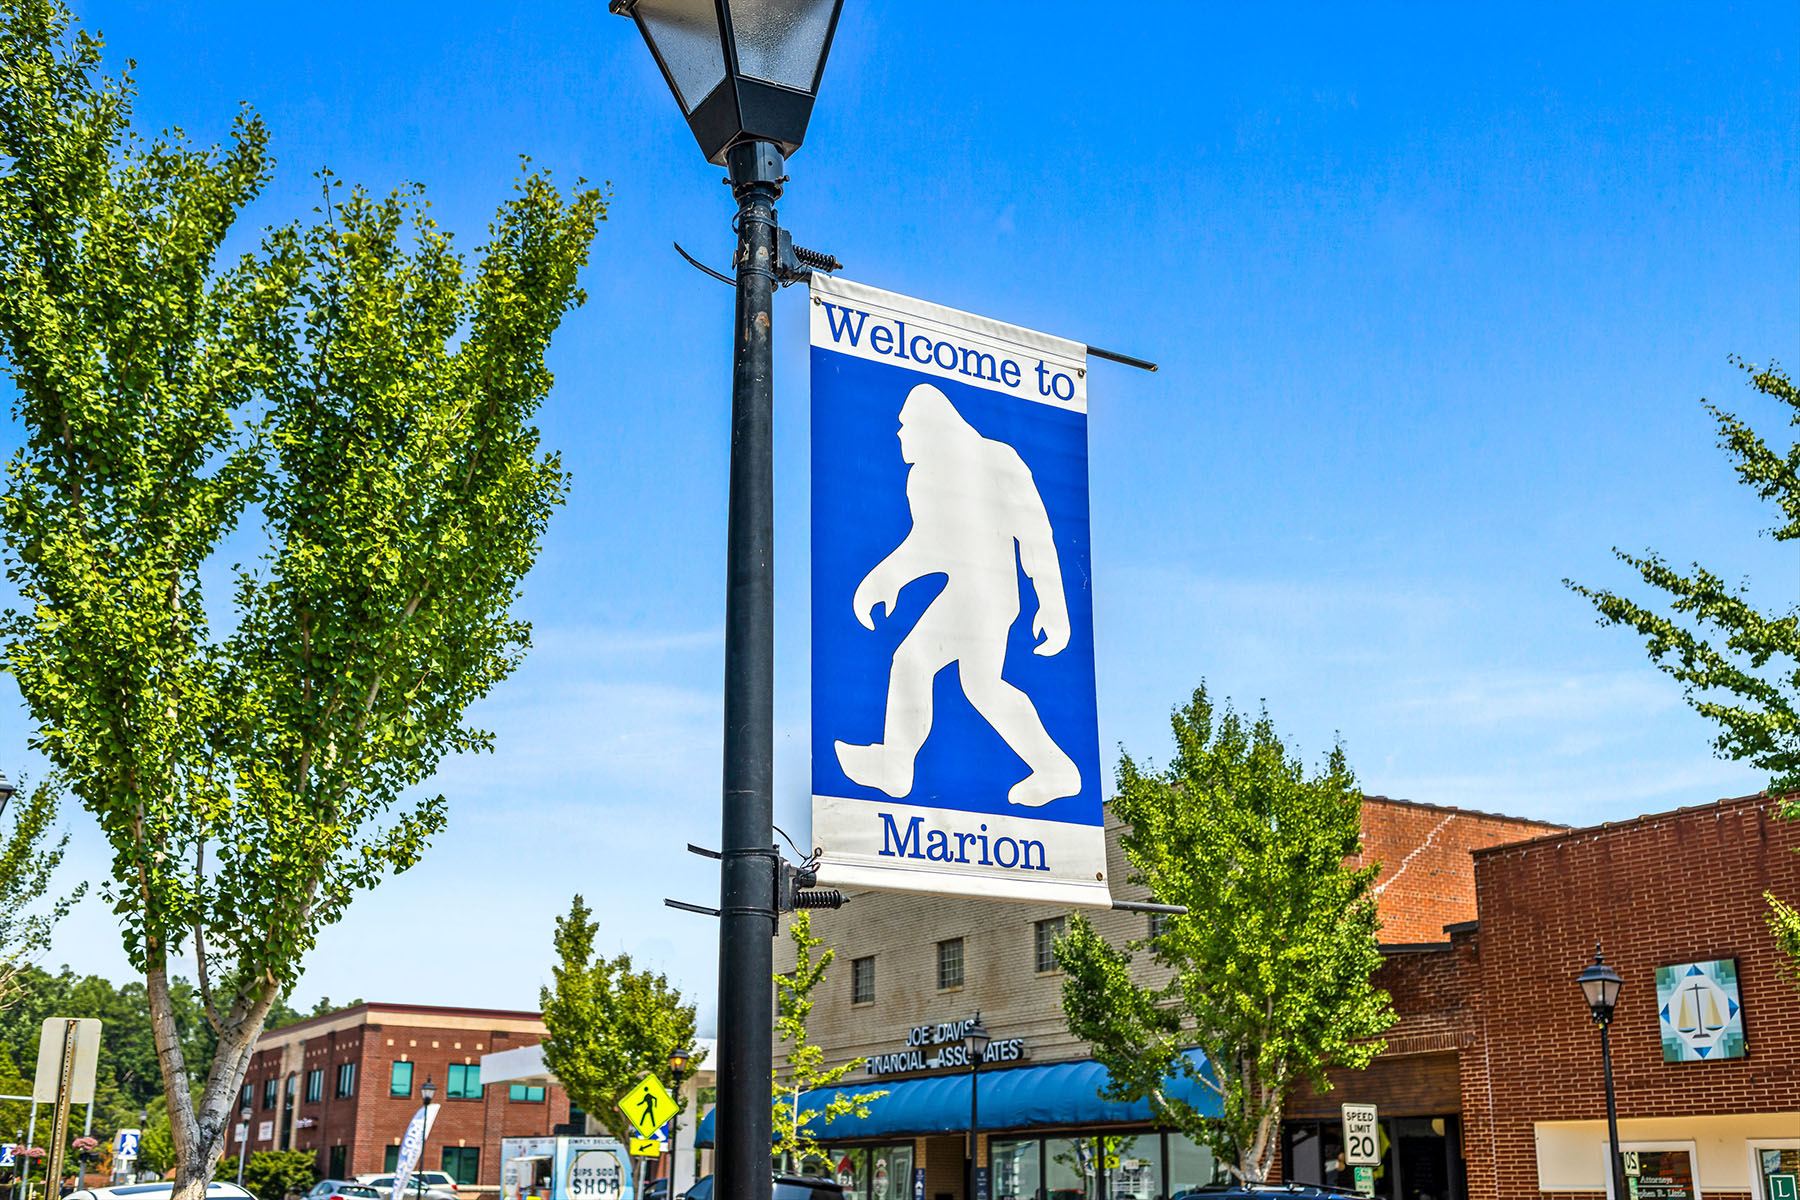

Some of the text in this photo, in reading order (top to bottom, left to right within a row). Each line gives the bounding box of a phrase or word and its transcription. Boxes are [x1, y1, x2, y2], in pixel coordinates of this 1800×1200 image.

[821, 301, 1075, 401] Welcome to
[878, 812, 1050, 871] Marion
[906, 1025, 930, 1047] JOE
[865, 1039, 1021, 1075] FINANCIAL ASSOIATES
[1346, 1111, 1374, 1122] SPEED
[1349, 1124, 1371, 1134] LIMIT
[1349, 1135, 1375, 1158] 20
[572, 1168, 593, 1177] SIPS
[1639, 1175, 1673, 1185] Attorneys
[572, 1178, 619, 1195] SHOP
[1776, 1180, 1791, 1198] L
